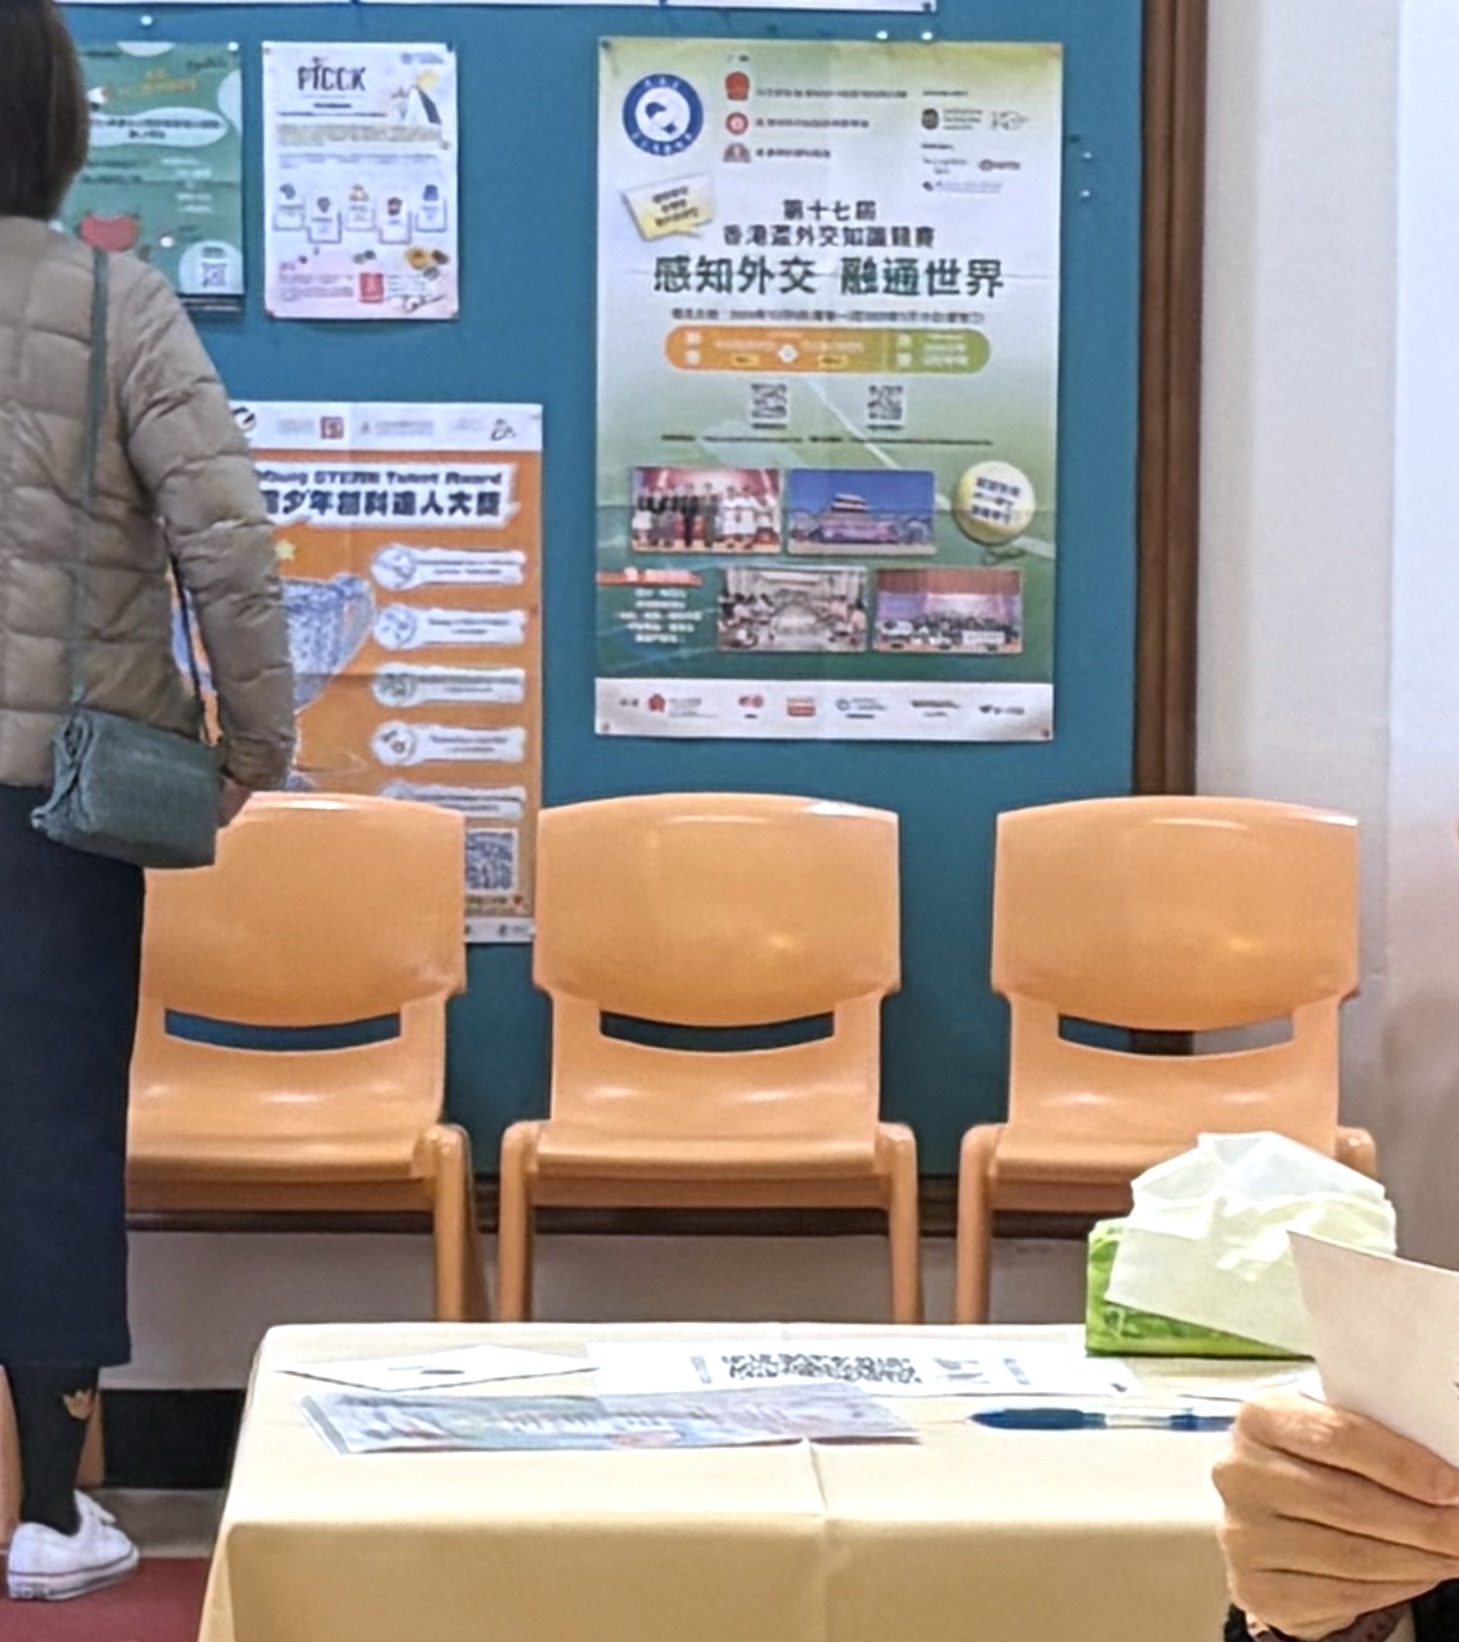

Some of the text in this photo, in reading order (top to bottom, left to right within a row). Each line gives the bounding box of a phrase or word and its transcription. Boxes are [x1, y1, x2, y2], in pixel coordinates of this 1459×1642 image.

[783, 199, 878, 221] 第十七屆
[724, 224, 935, 248] 香港盃外交知識競賽
[654, 256, 1005, 298] 感知外交 融通世界
